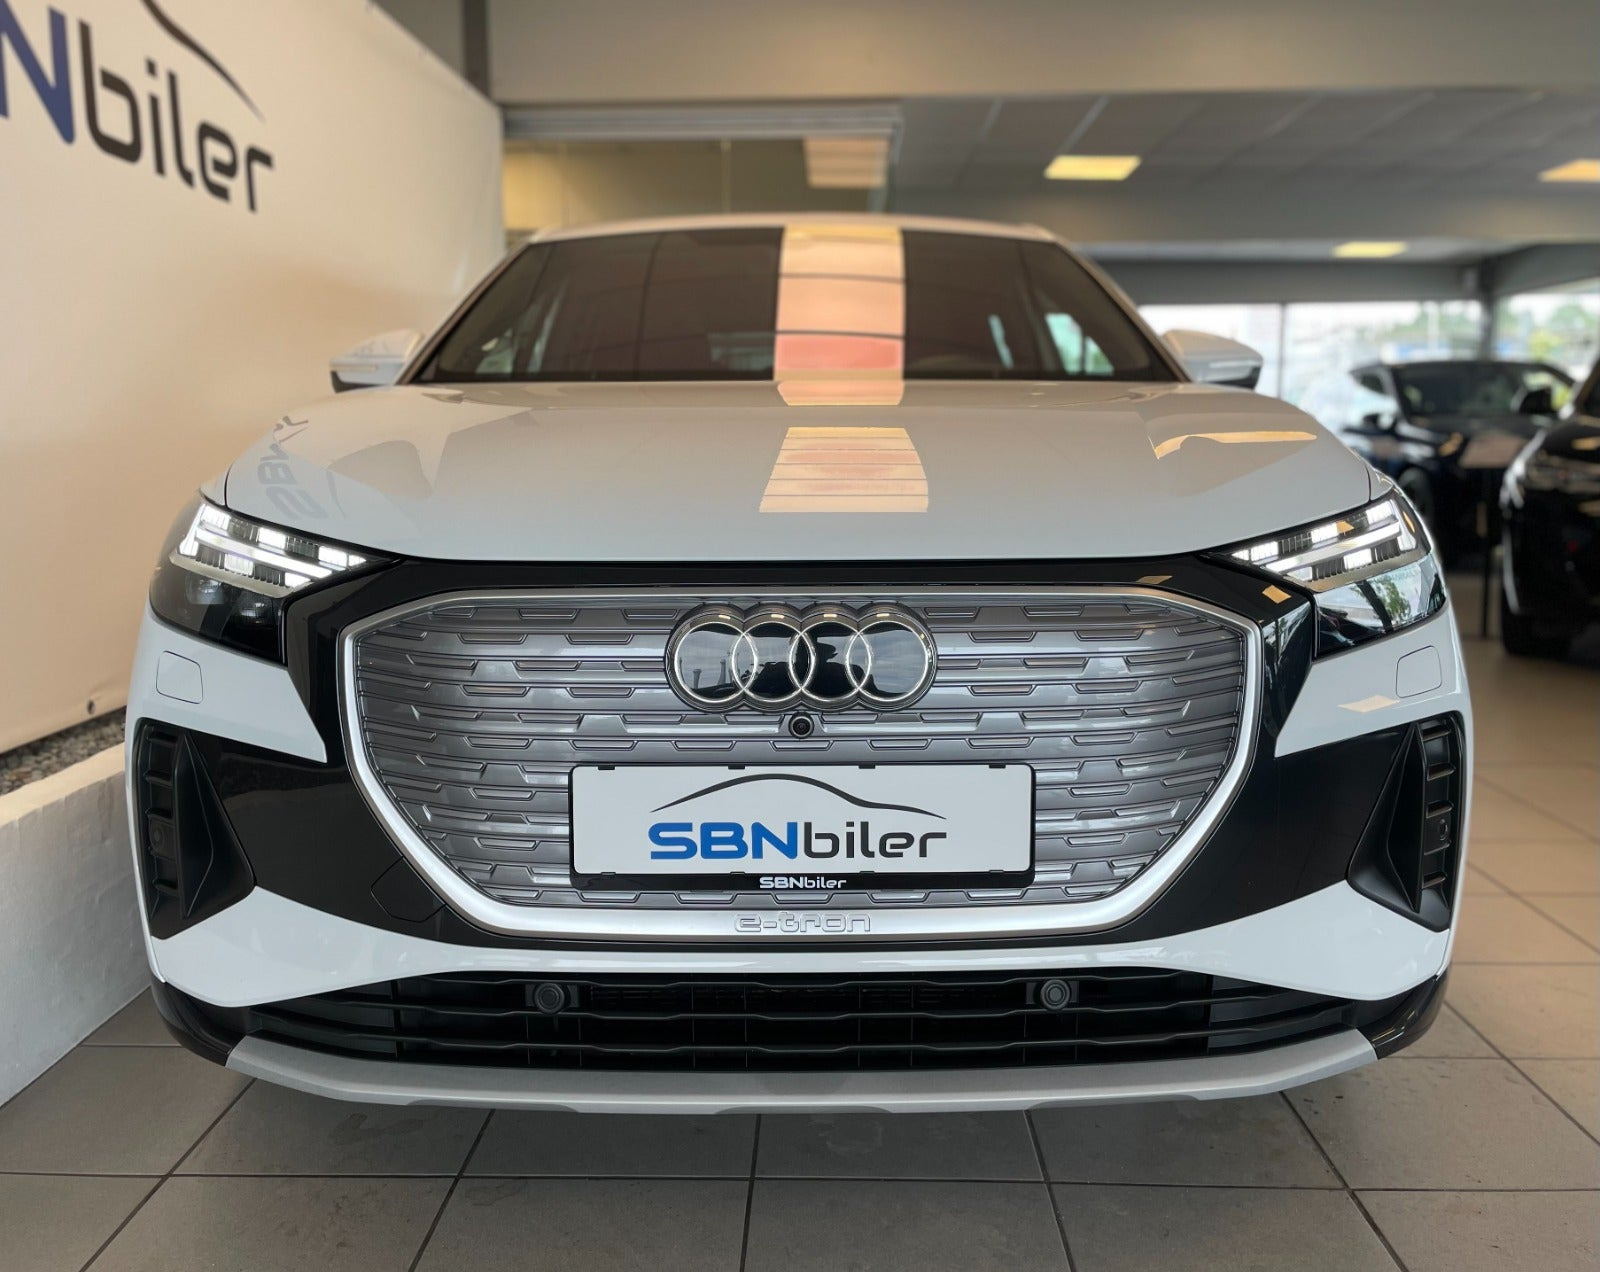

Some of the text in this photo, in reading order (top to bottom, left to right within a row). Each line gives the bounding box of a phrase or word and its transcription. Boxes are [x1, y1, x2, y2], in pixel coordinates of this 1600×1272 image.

[648, 821, 947, 859] SBNbiler
[759, 876, 847, 889] SBNbiler
[734, 911, 871, 932] e-tron
